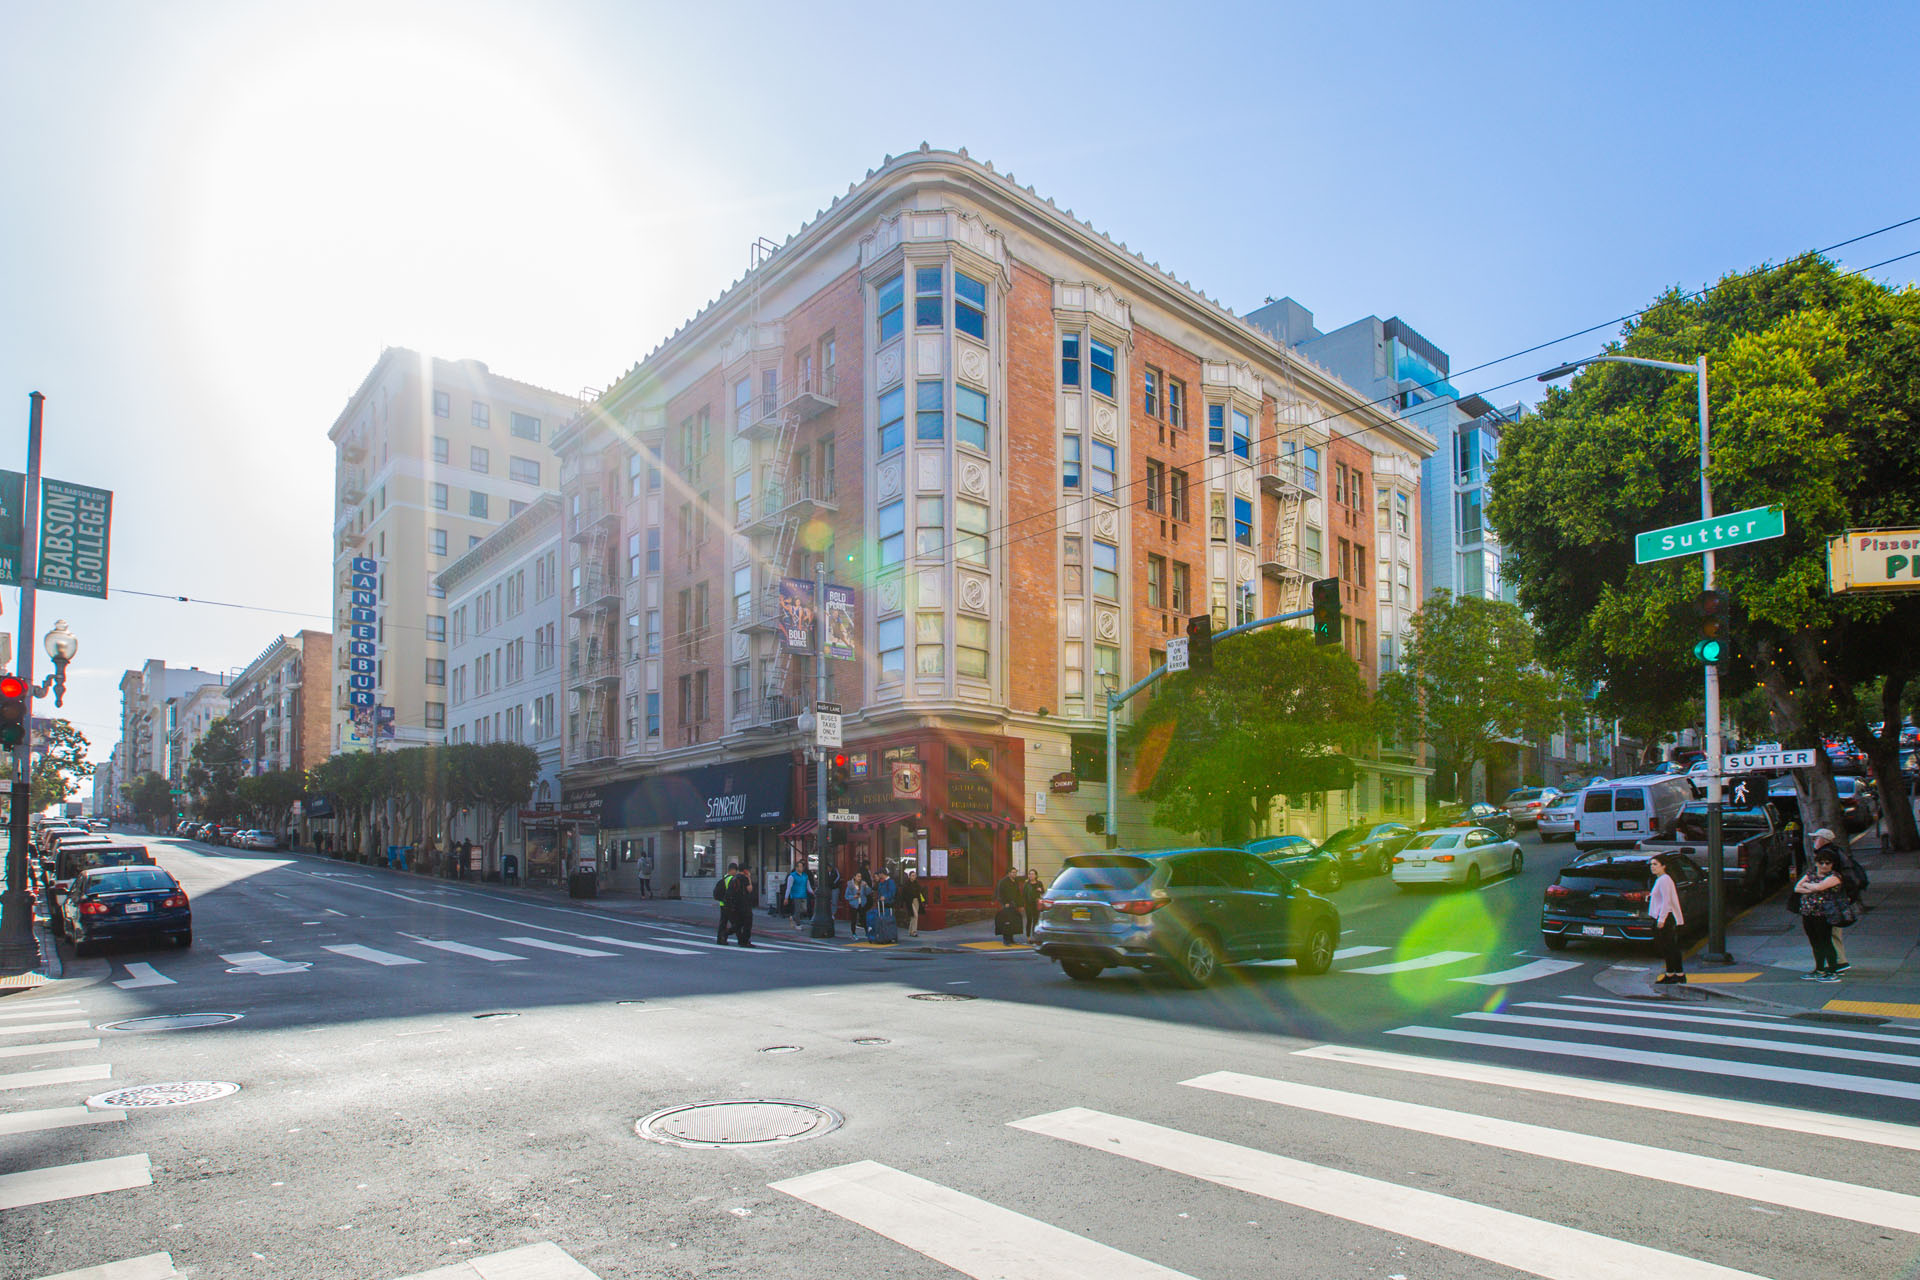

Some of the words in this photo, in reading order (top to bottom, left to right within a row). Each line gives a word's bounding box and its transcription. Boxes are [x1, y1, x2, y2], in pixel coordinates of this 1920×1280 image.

[43, 492, 77, 580] BABSON
[75, 498, 106, 584] COLLEGE
[1662, 521, 1756, 551] Sutter
[1860, 538, 1920, 551] Pizzer
[42, 577, 57, 586] SAN
[59, 580, 103, 592] FRANCISCO
[829, 591, 846, 603] BOLD
[357, 561, 372, 705] CANTERBUR
[788, 629, 807, 641] BOLD
[789, 640, 807, 648] WORKS
[1169, 661, 1186, 669] ARROW
[820, 714, 837, 722] BUSES
[1730, 753, 1807, 768] SUTTER
[705, 794, 747, 818] SANRAKU
